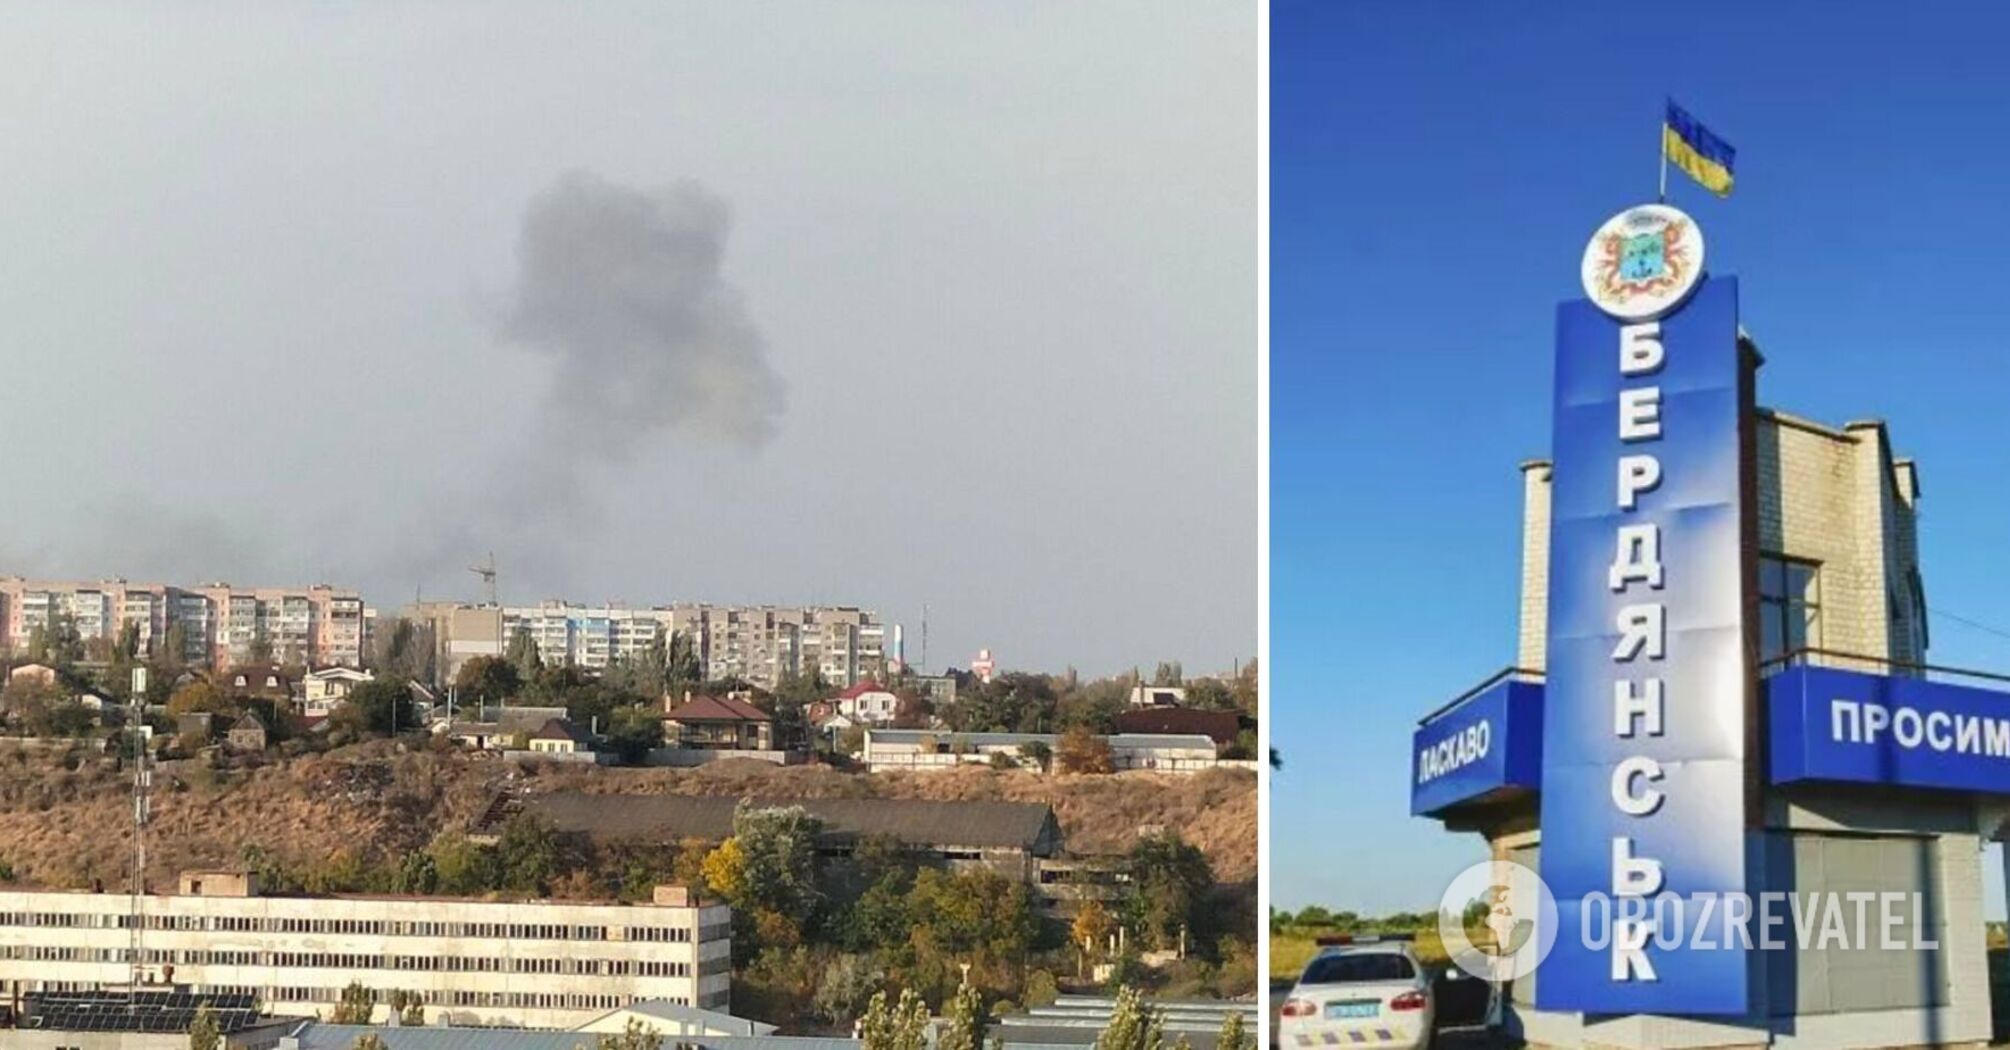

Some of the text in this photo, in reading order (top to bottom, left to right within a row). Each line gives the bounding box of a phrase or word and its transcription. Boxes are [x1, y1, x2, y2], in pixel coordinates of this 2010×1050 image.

[1609, 322, 1664, 983] БЕРДЯНСЬК
[1418, 719, 1490, 784] ЛАСКАВО
[1831, 700, 2010, 758] ПРОСИМ
